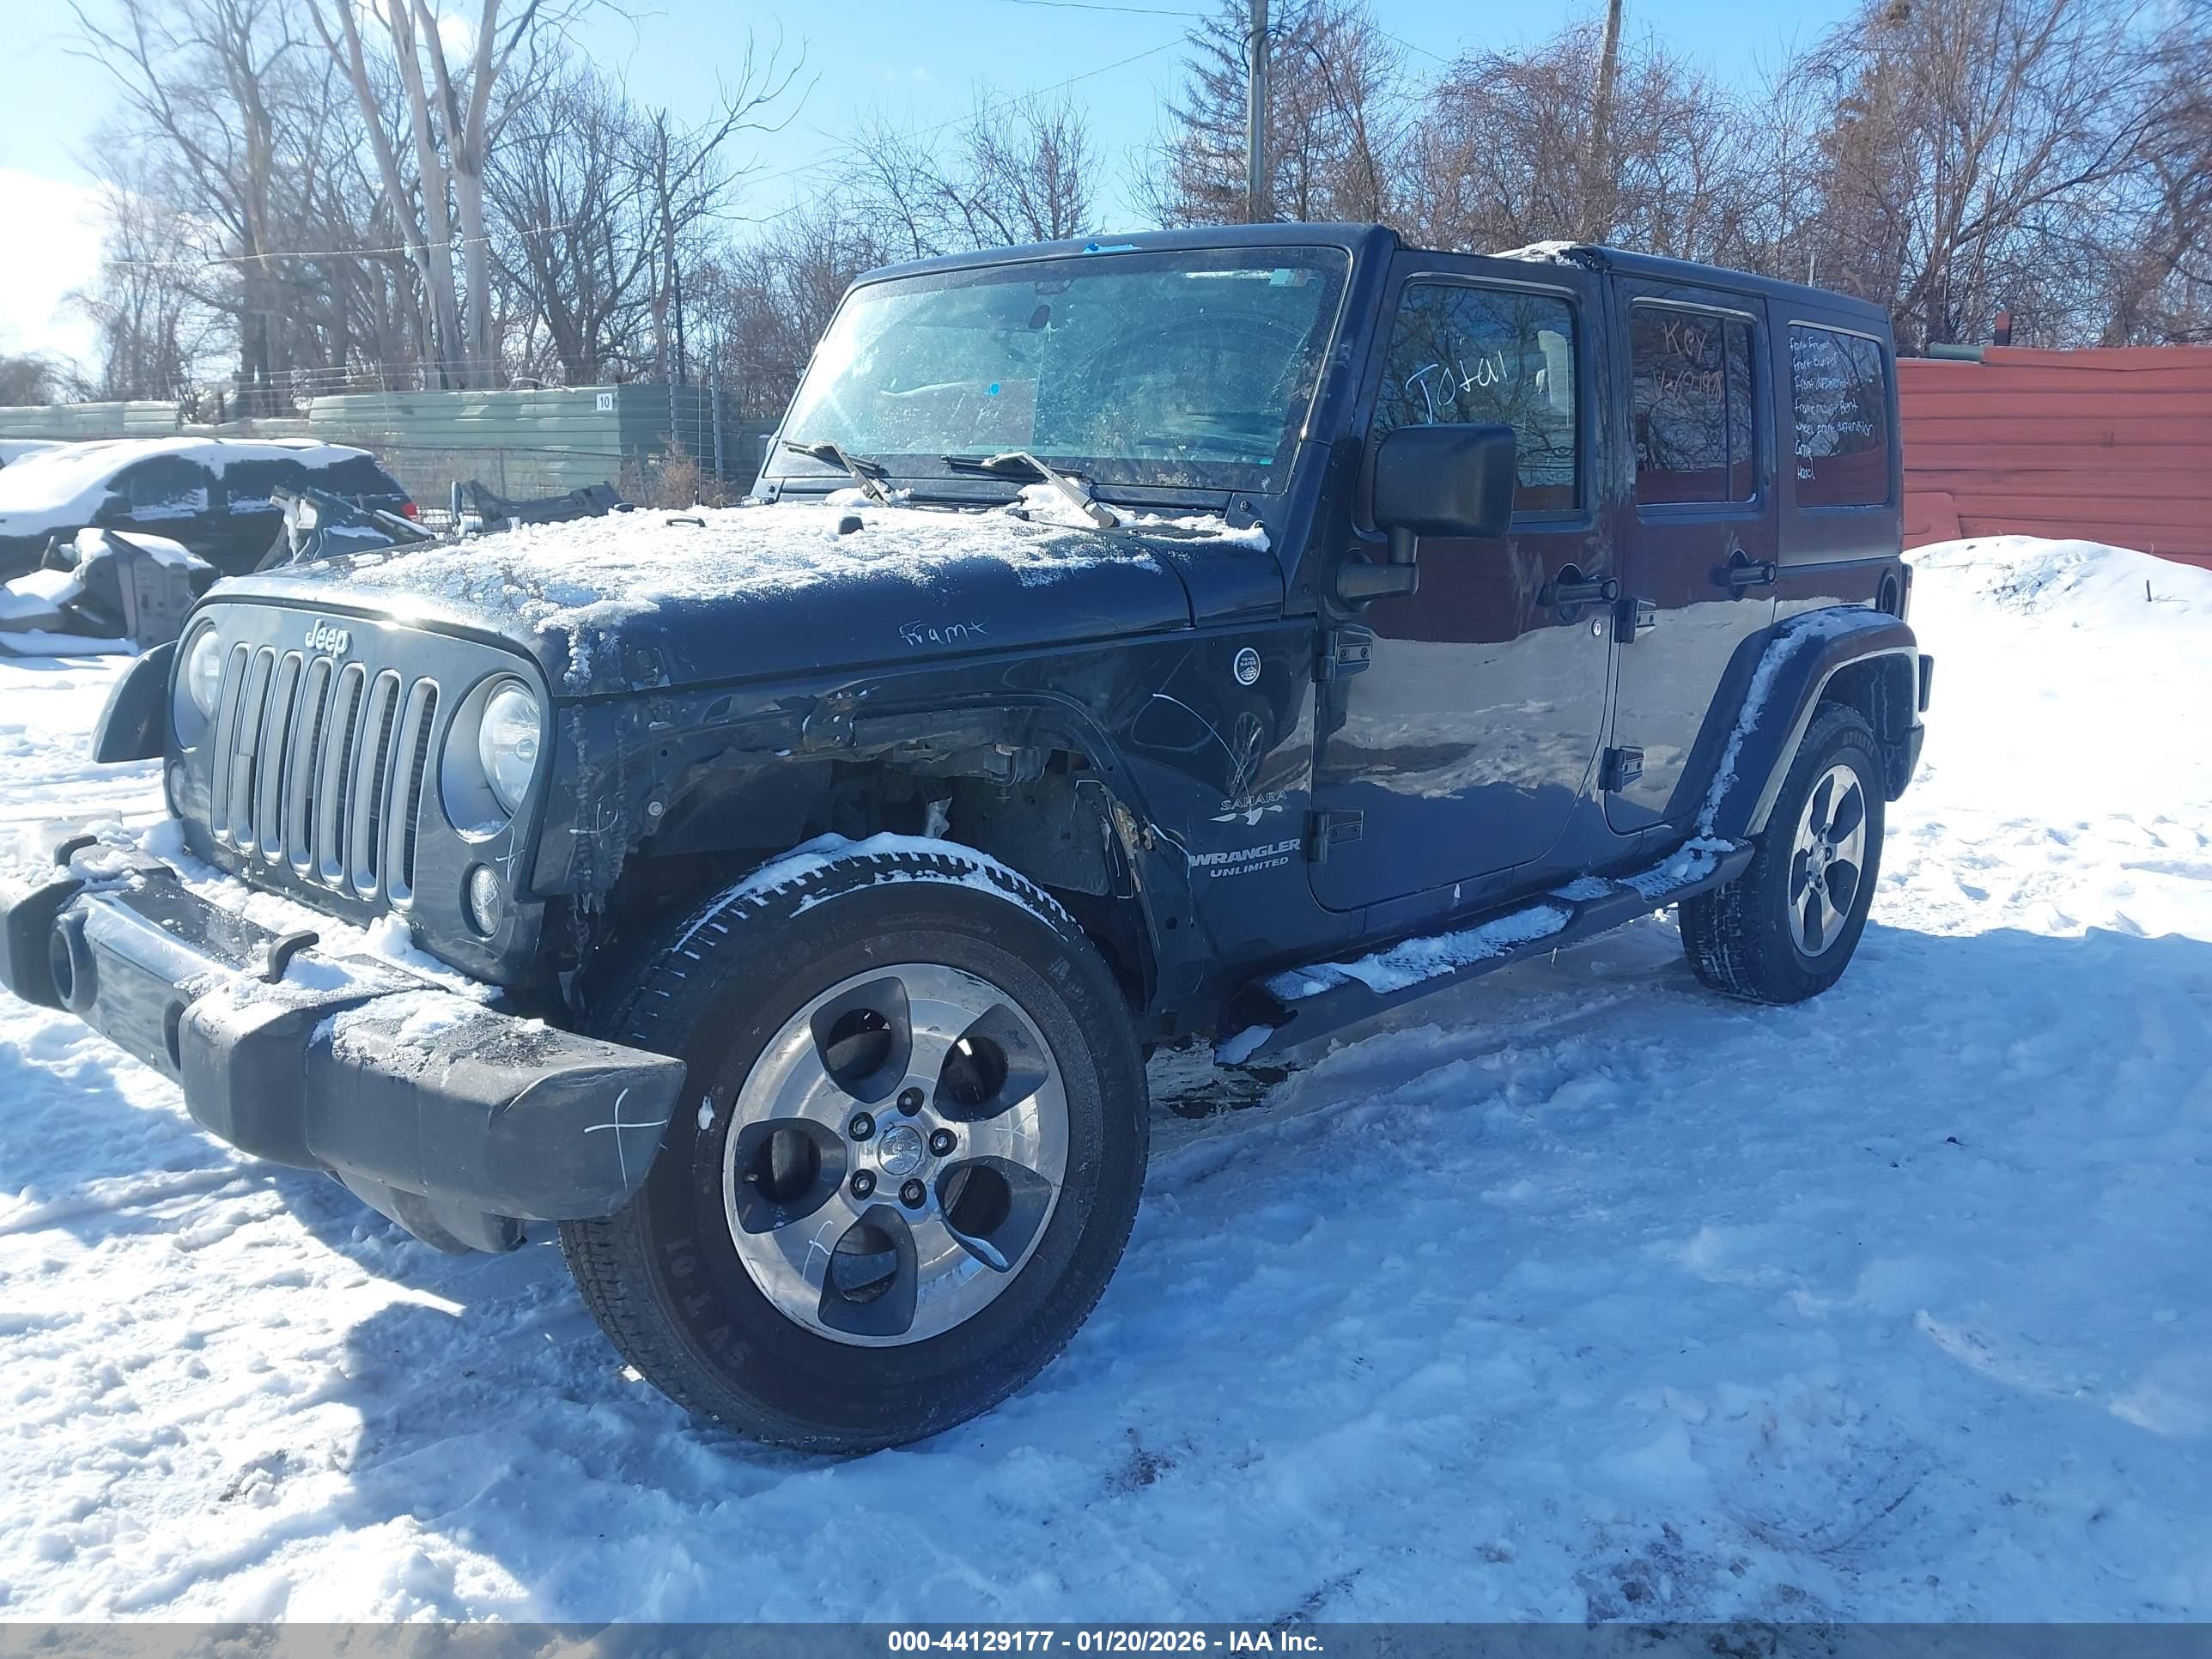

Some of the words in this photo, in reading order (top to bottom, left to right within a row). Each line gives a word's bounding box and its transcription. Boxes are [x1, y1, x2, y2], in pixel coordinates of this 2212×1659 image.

[600, 396, 610, 408] 10
[305, 618, 349, 659] Jeep
[1220, 790, 1287, 811] SAHARA
[1189, 838, 1301, 867] WRANGLER
[1211, 857, 1288, 878] UNLIMITED
